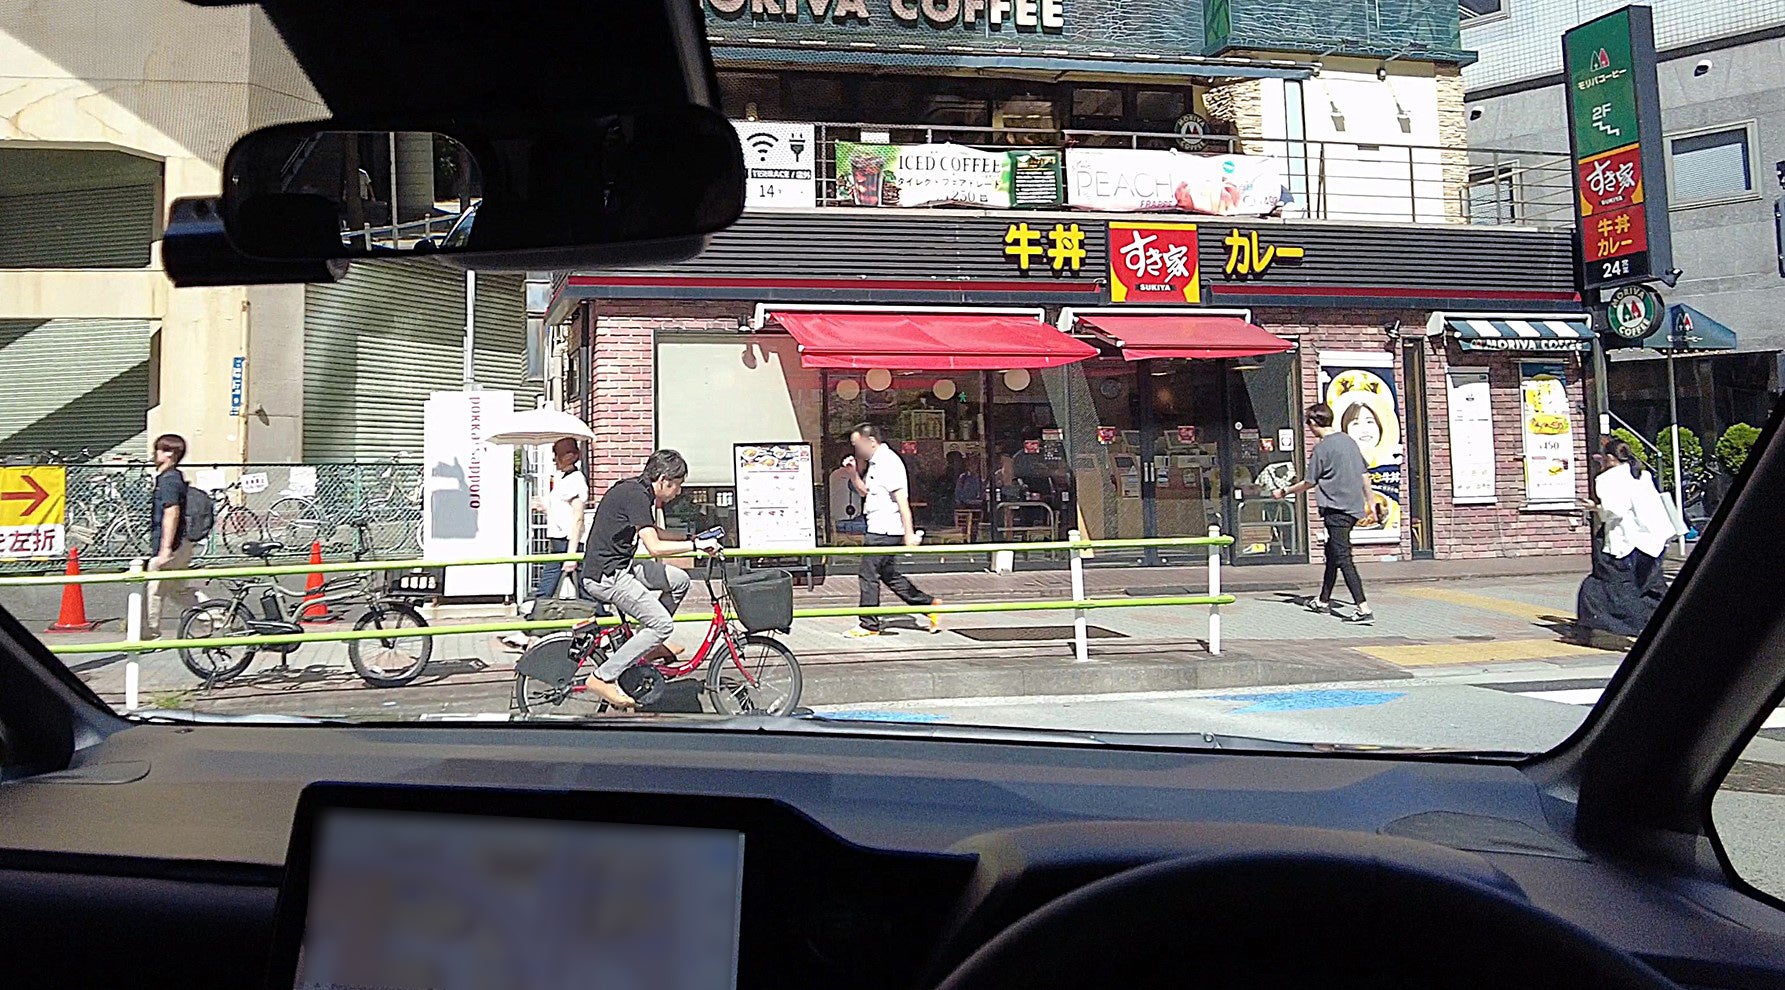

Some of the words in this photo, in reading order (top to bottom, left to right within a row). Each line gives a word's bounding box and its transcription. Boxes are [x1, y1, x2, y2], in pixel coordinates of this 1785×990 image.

[1578, 69, 1627, 90] モリバコーヒー
[1592, 103, 1612, 120] 2F
[898, 155, 936, 171] ICED
[940, 155, 1001, 174] COFFEE
[1076, 170, 1174, 199] PEACH
[1585, 160, 1636, 195] すき家
[1598, 213, 1631, 237] 牛丼
[1004, 222, 1087, 270] 牛丼
[1120, 230, 1190, 284] すき家
[1225, 228, 1304, 274] カレー
[1597, 236, 1633, 257] カレー
[1139, 284, 1171, 292] SUKIYA
[1611, 287, 1645, 308] MORIVA
[1486, 339, 1537, 350] MORIVA
[1540, 339, 1583, 350] COFFEE
[0, 529, 56, 552] 左折
